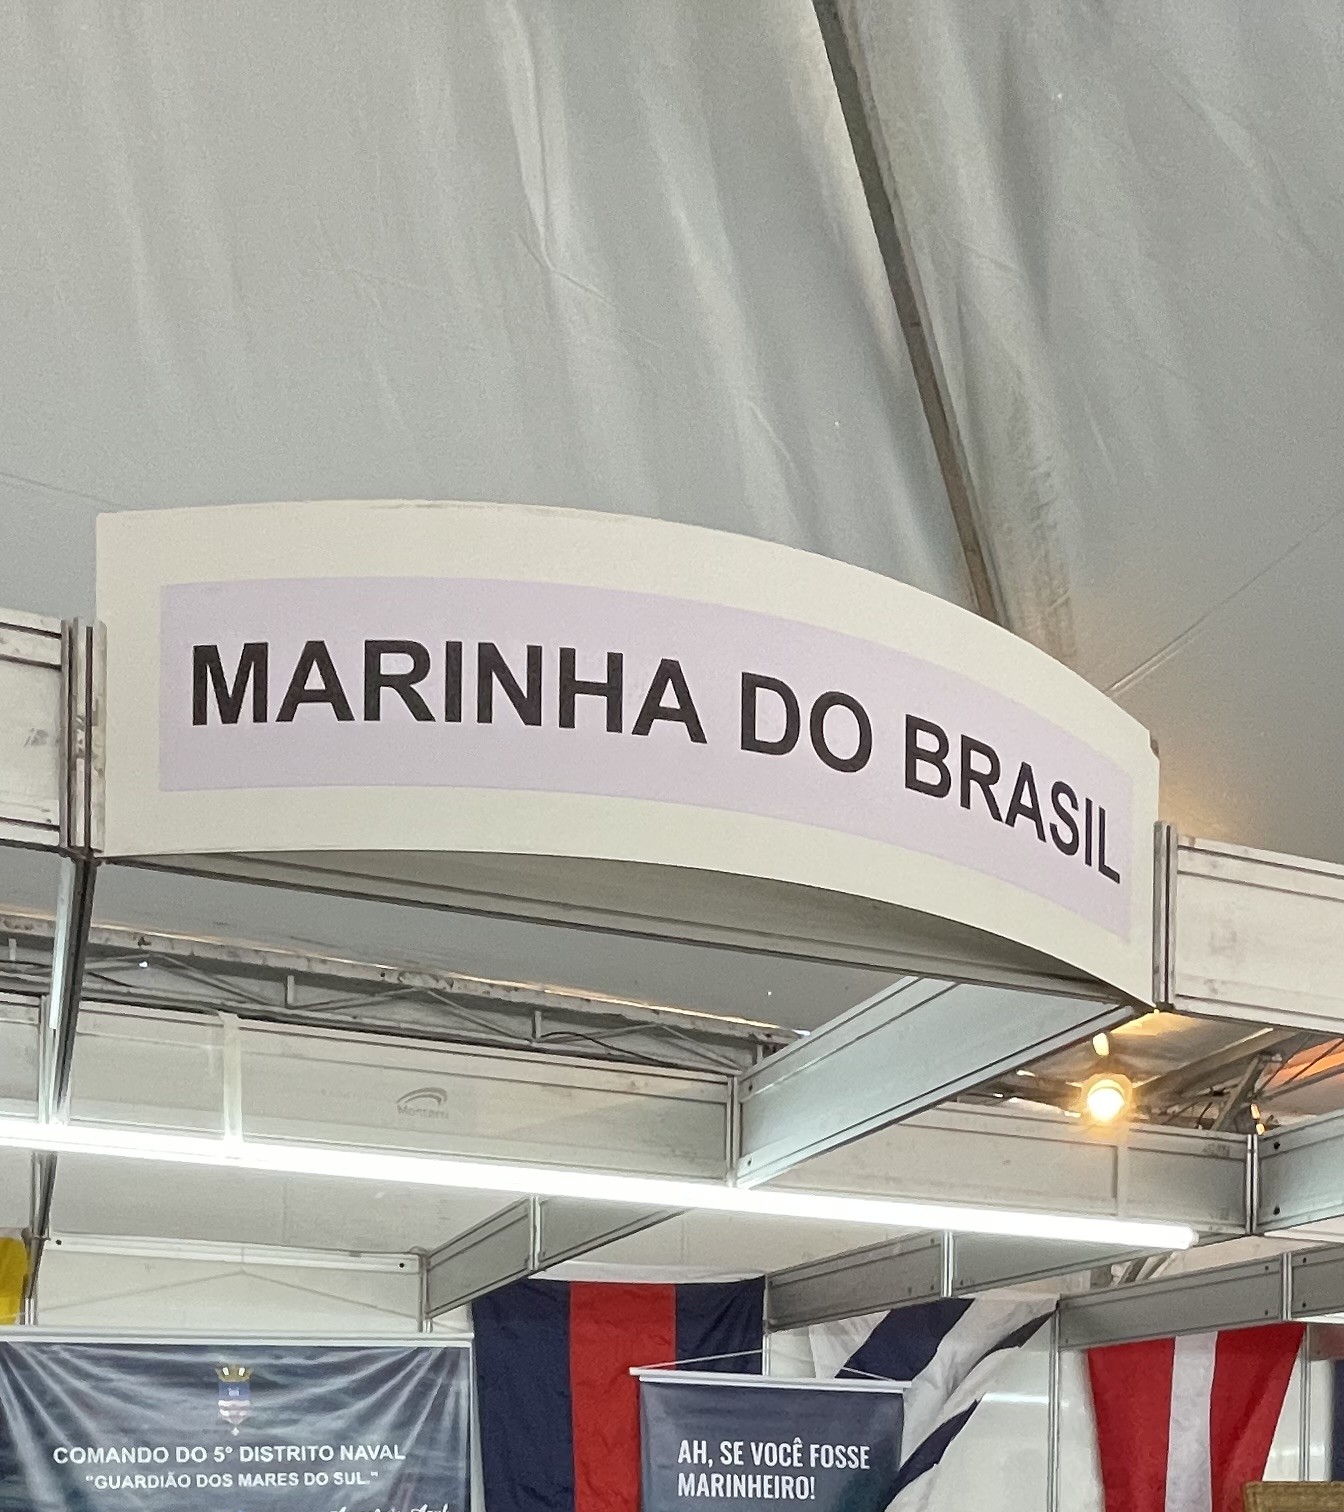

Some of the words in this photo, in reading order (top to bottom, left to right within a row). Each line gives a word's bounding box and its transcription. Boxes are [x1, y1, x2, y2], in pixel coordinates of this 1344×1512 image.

[190, 638, 708, 745] MARINHA
[739, 670, 874, 775] DO
[903, 713, 1122, 885] BRASIL
[53, 1446, 170, 1464] COMANDO
[175, 1446, 207, 1464] DO
[239, 1445, 335, 1463] DISTRITO
[340, 1444, 406, 1461] NAVAL
[677, 1439, 713, 1468] AH,
[719, 1441, 745, 1466] SE
[750, 1436, 804, 1468] VOCÊ
[809, 1444, 871, 1470] FOSSE
[196, 1474, 234, 1489] DOS
[237, 1472, 299, 1487] MARES
[304, 1472, 329, 1486] DO
[677, 1472, 816, 1500] MARINHEIRO!
